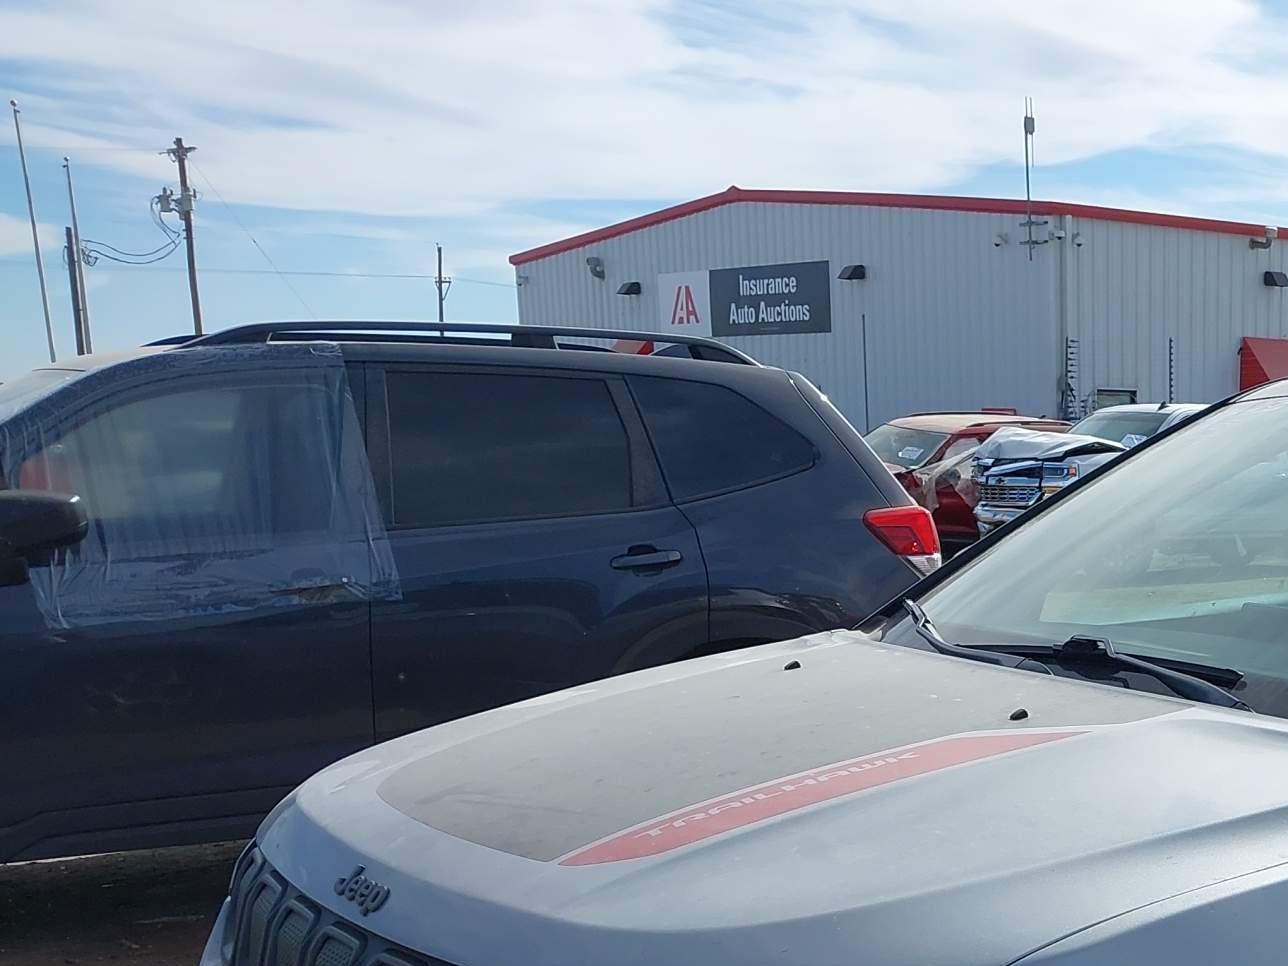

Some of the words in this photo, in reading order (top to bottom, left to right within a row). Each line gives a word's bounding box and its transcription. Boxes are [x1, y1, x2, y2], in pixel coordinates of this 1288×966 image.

[738, 275, 798, 297] Insurance
[729, 303, 756, 325] Auto
[758, 300, 811, 323] Auctions
[333, 863, 391, 917] Jeep
